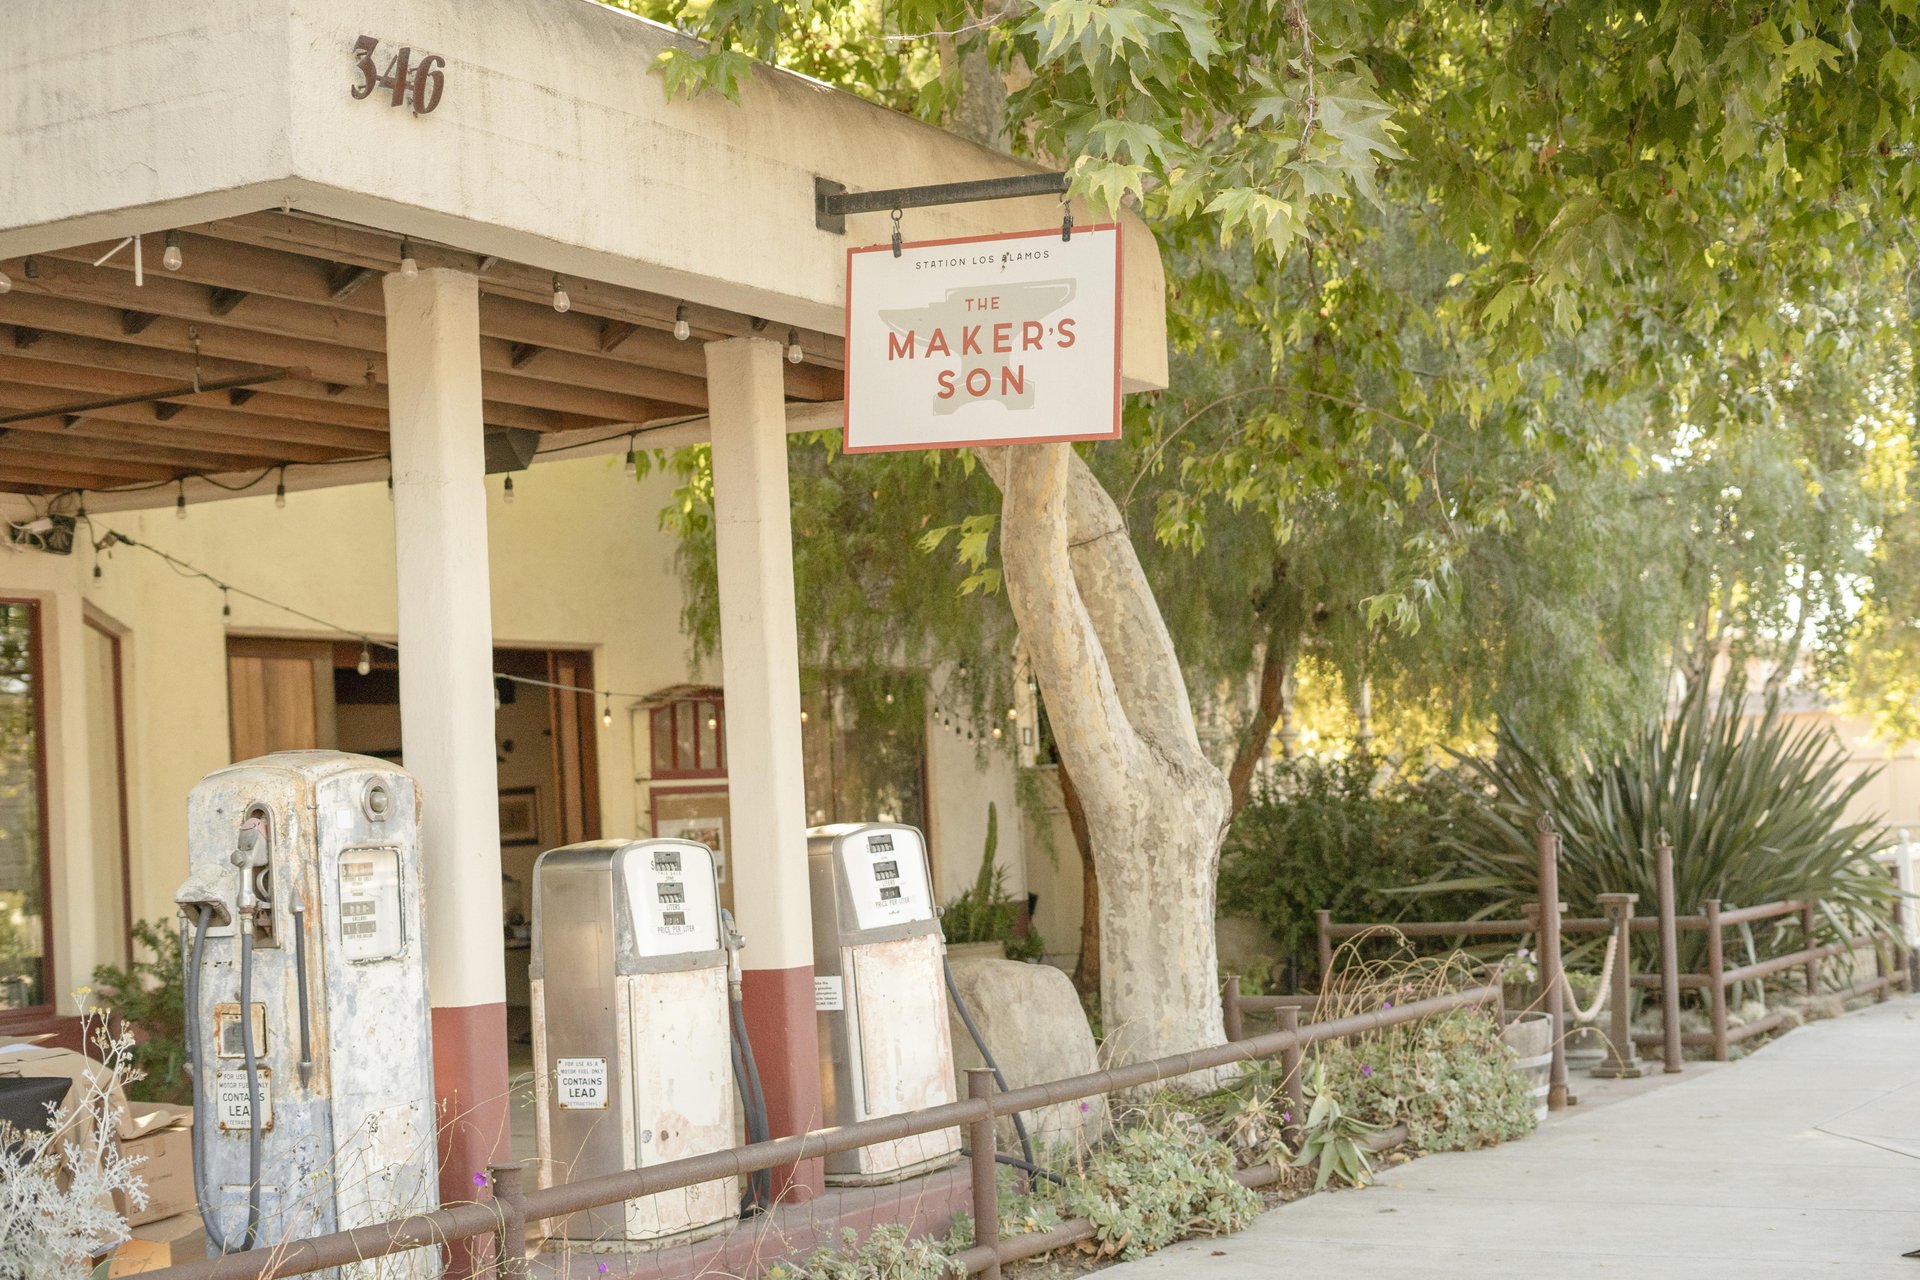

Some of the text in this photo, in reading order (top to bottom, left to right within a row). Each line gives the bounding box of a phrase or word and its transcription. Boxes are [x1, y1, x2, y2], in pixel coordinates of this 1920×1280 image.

[351, 35, 445, 114] 346
[915, 251, 1050, 270] STATION LOS ALAMOS
[965, 296, 1000, 312] THE
[888, 318, 1077, 361] MAKER'S
[937, 365, 1024, 400] SON
[657, 926, 671, 934] PRICE
[222, 1093, 265, 1101] CONTAS
[569, 1088, 596, 1097] LEAD
[229, 1106, 250, 1116] LEA
